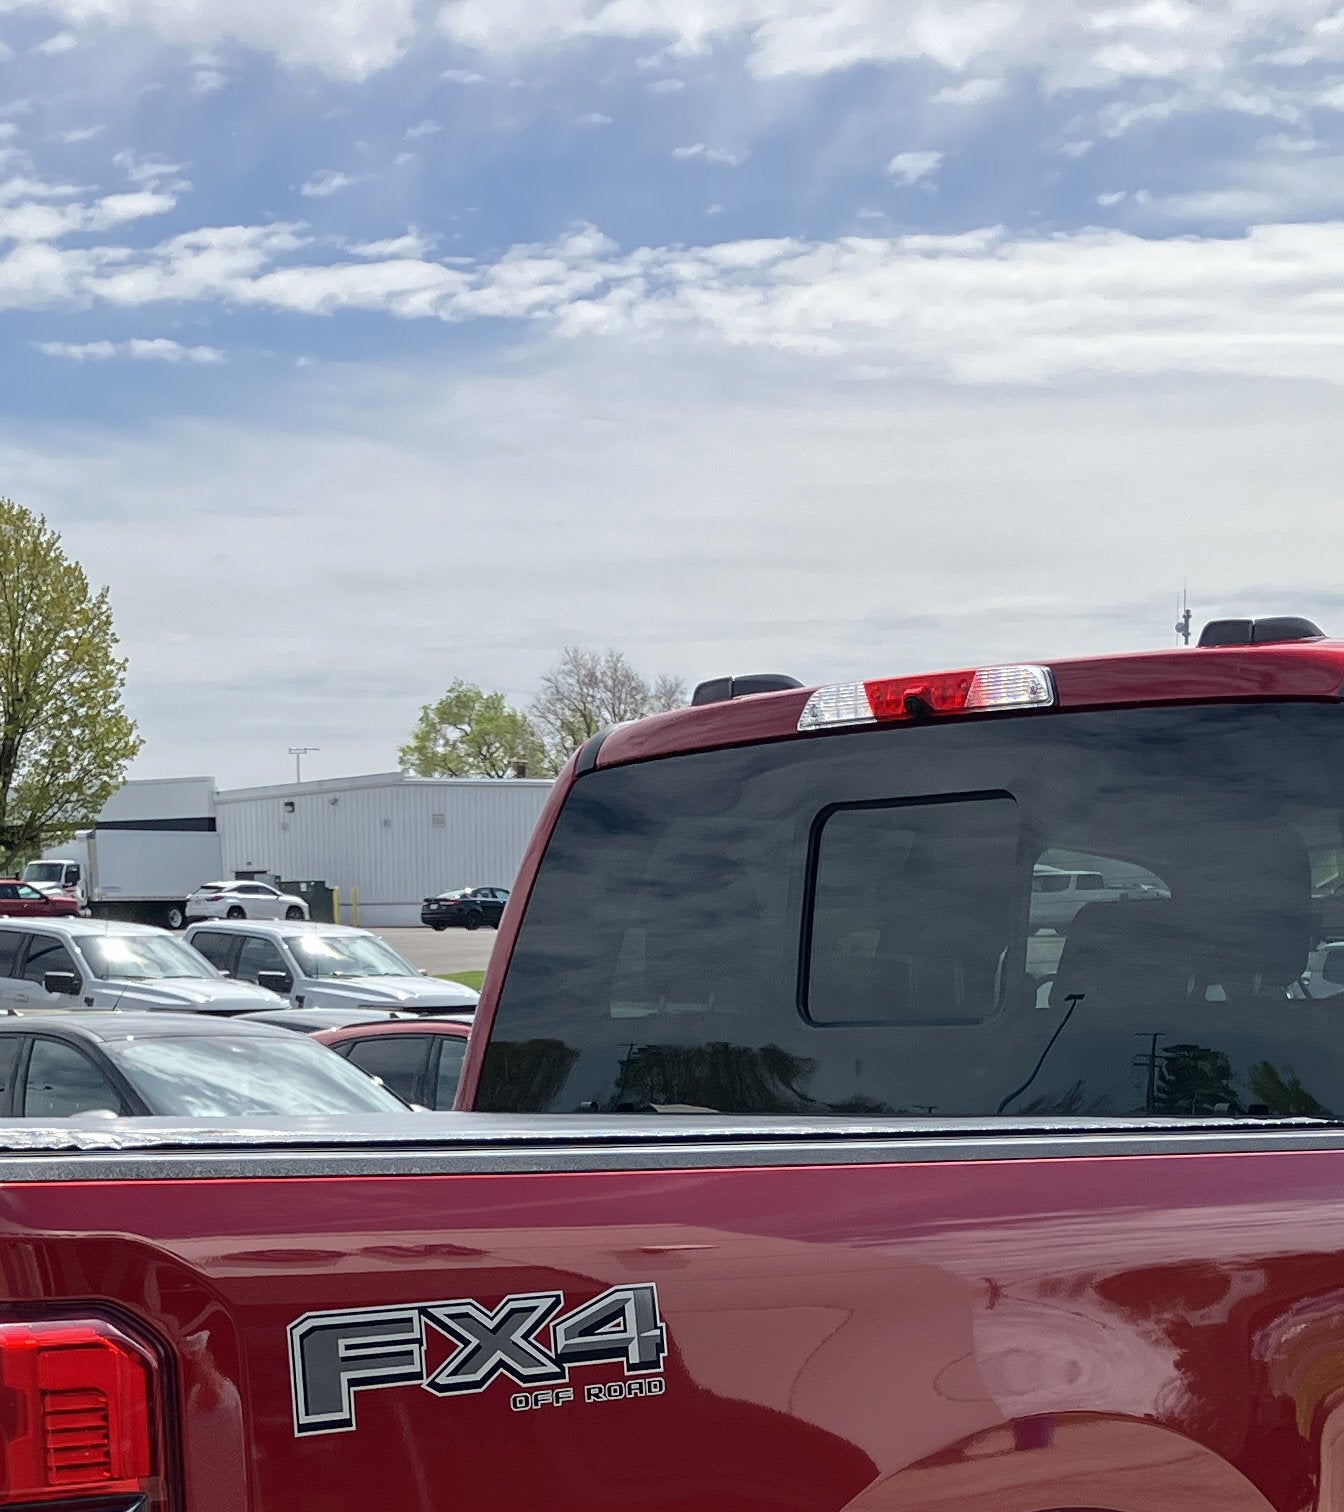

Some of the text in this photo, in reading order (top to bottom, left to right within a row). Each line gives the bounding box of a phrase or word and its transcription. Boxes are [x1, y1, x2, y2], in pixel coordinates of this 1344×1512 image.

[286, 1281, 668, 1438] FX4
[510, 1377, 666, 1412] OFF ROAD
